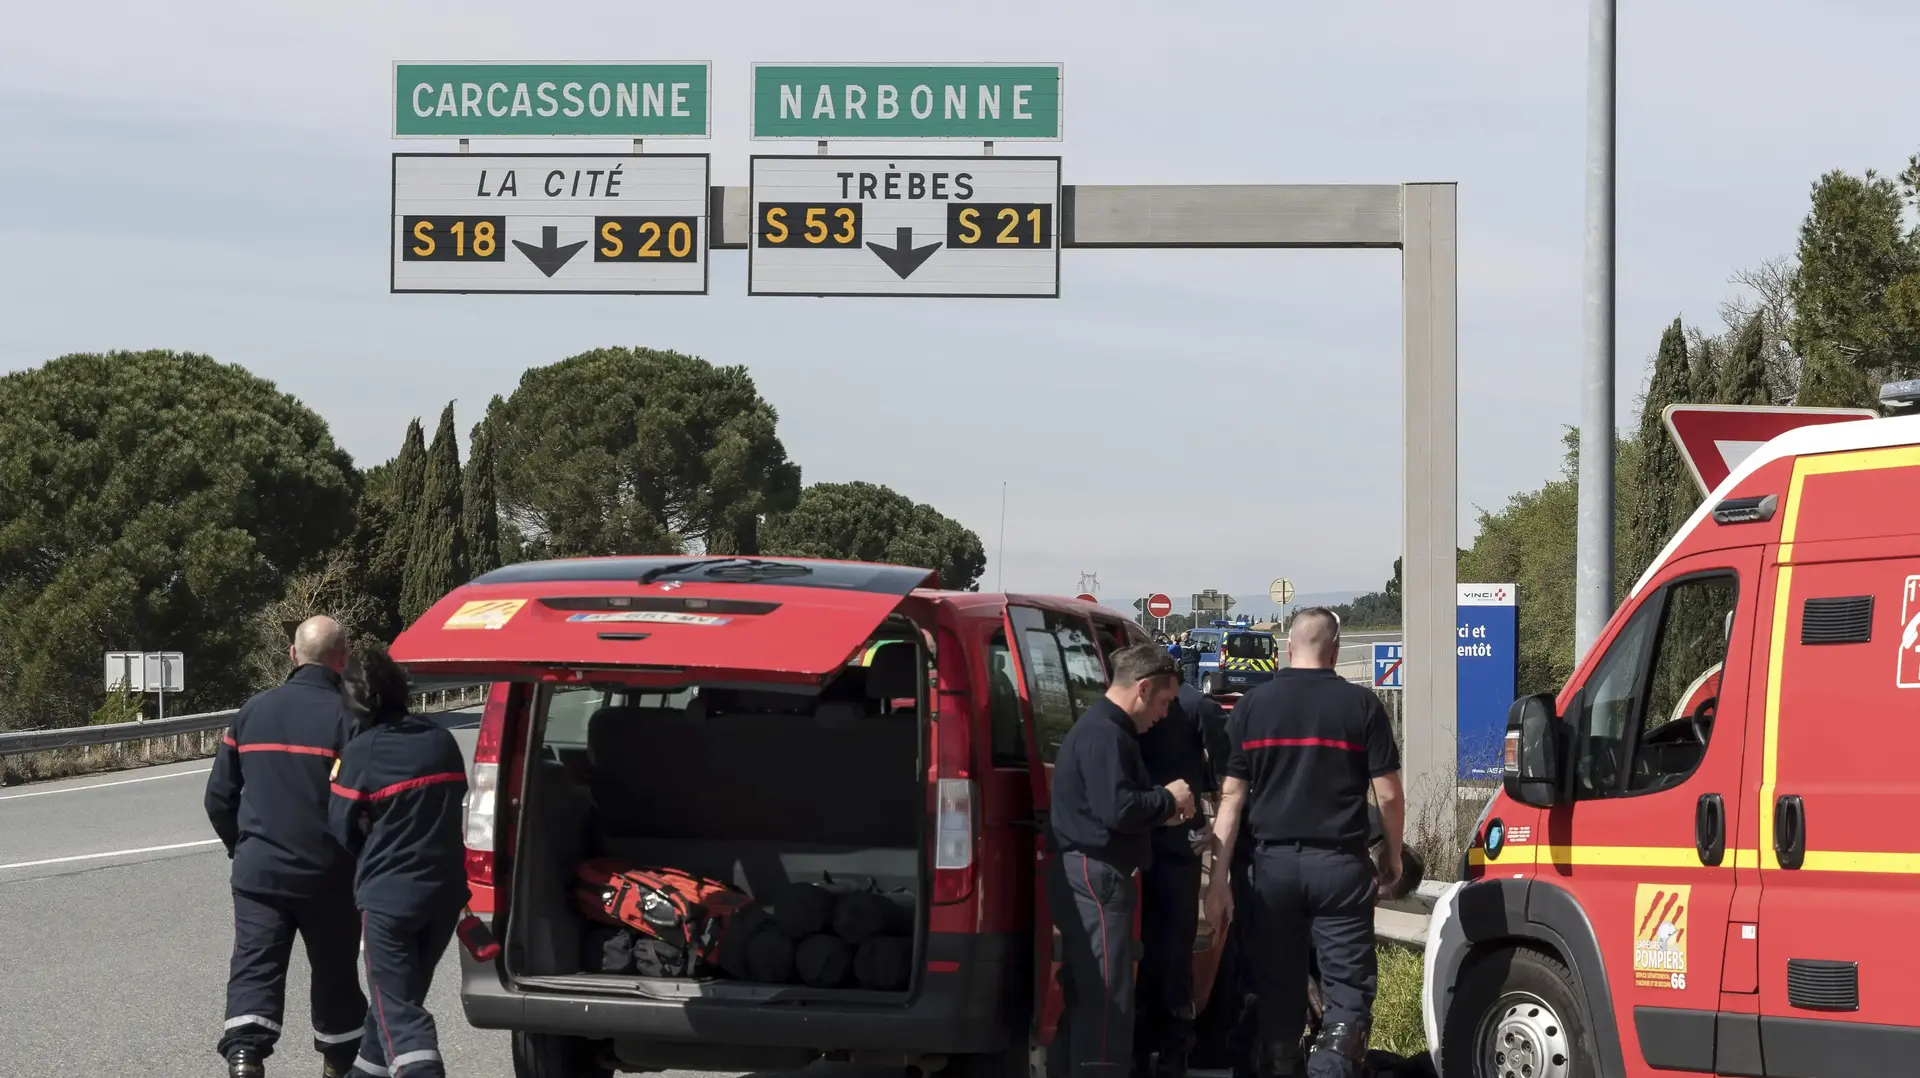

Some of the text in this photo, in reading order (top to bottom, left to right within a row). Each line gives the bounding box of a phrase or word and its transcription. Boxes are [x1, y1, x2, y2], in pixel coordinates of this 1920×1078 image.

[412, 82, 690, 118] CARCASSONNE
[779, 84, 1033, 120] NARBONNE
[477, 163, 624, 198] LA CITÉ
[836, 163, 974, 201] TRÈBES
[413, 221, 496, 257] S 18
[601, 221, 692, 258] S 20
[765, 207, 855, 244] S 53
[959, 207, 1041, 244] S 21
[1472, 624, 1486, 638] et
[1635, 950, 1685, 970] POMPIERS
[1670, 972, 1686, 990] 66
